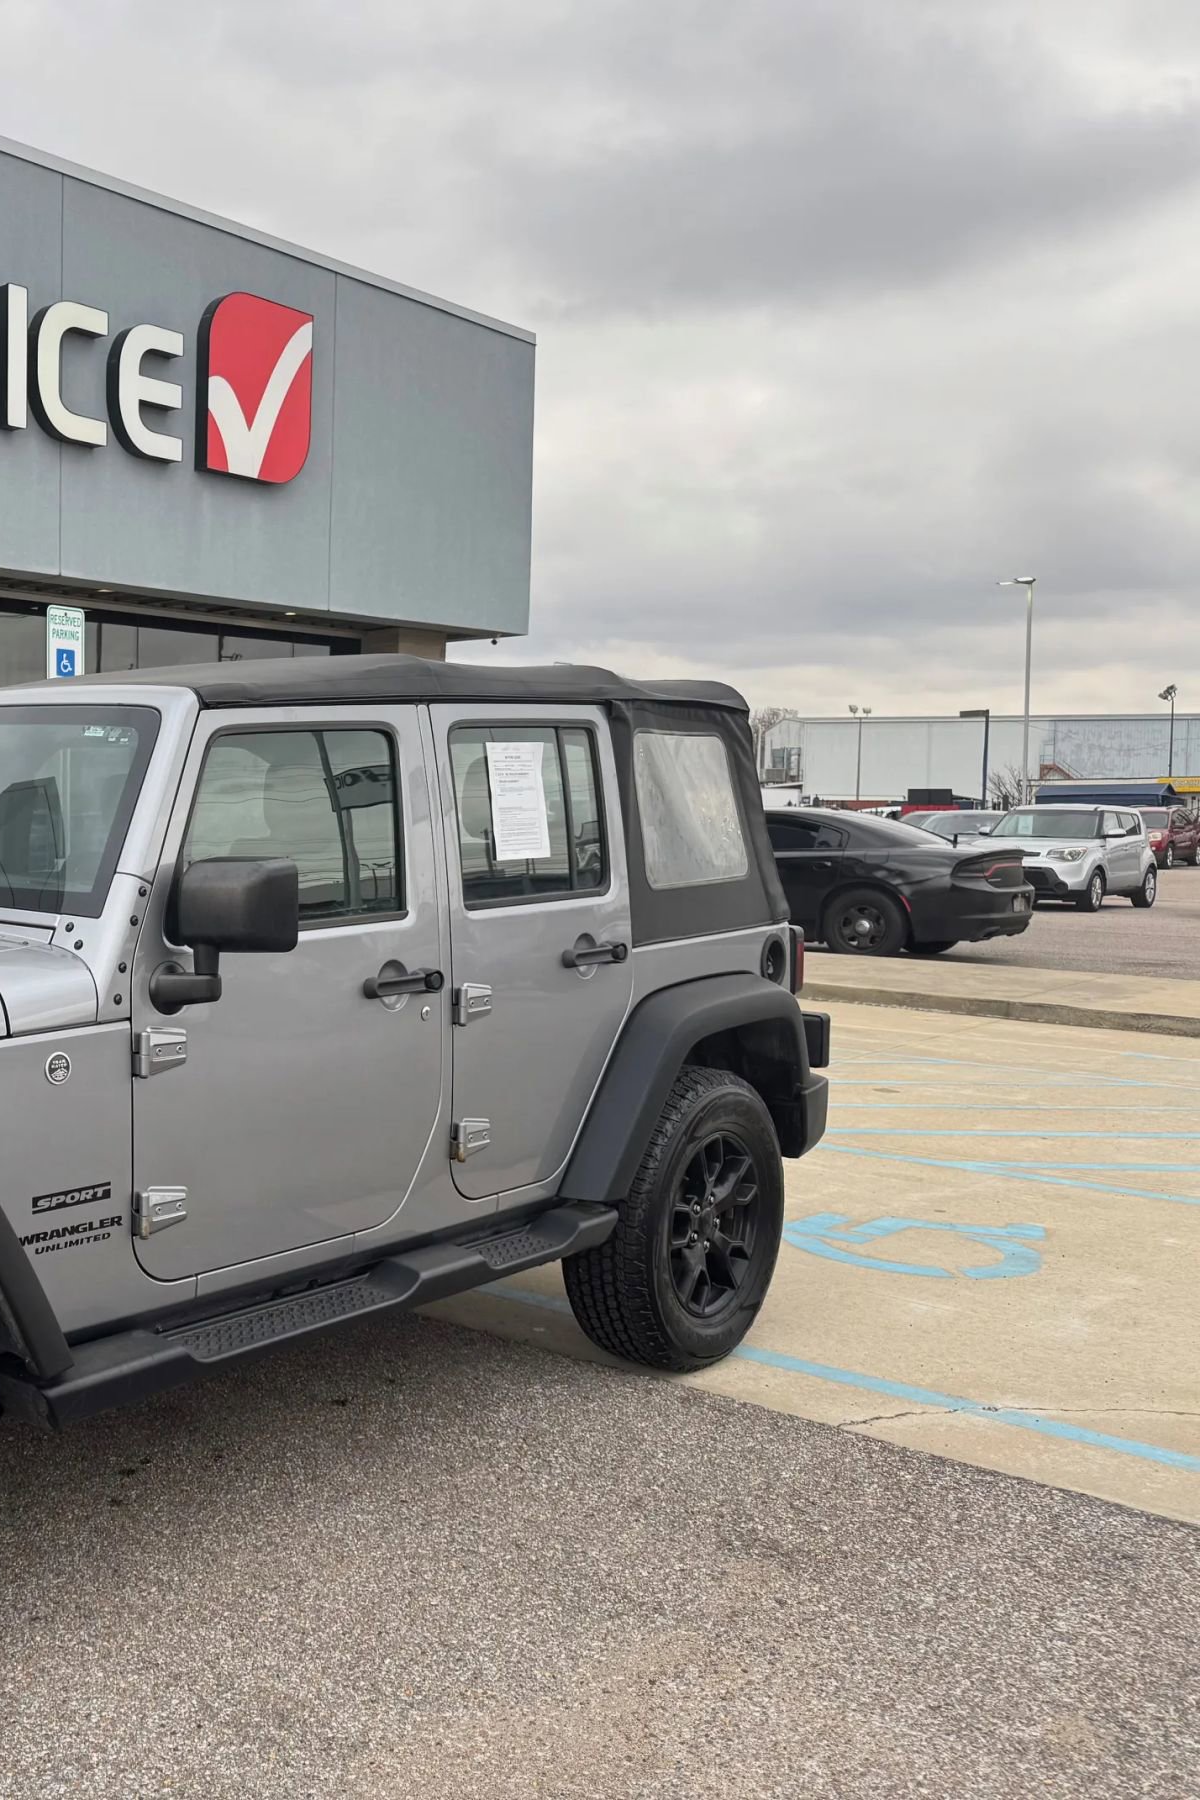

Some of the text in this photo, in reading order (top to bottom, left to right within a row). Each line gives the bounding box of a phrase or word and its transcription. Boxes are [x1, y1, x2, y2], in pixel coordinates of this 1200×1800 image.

[49, 613, 82, 628] RESERVED
[51, 628, 80, 641] PARKING
[34, 1185, 109, 1210] SPORT
[19, 1215, 123, 1247] WRANGLER
[35, 1232, 111, 1255] UNLIMITED
